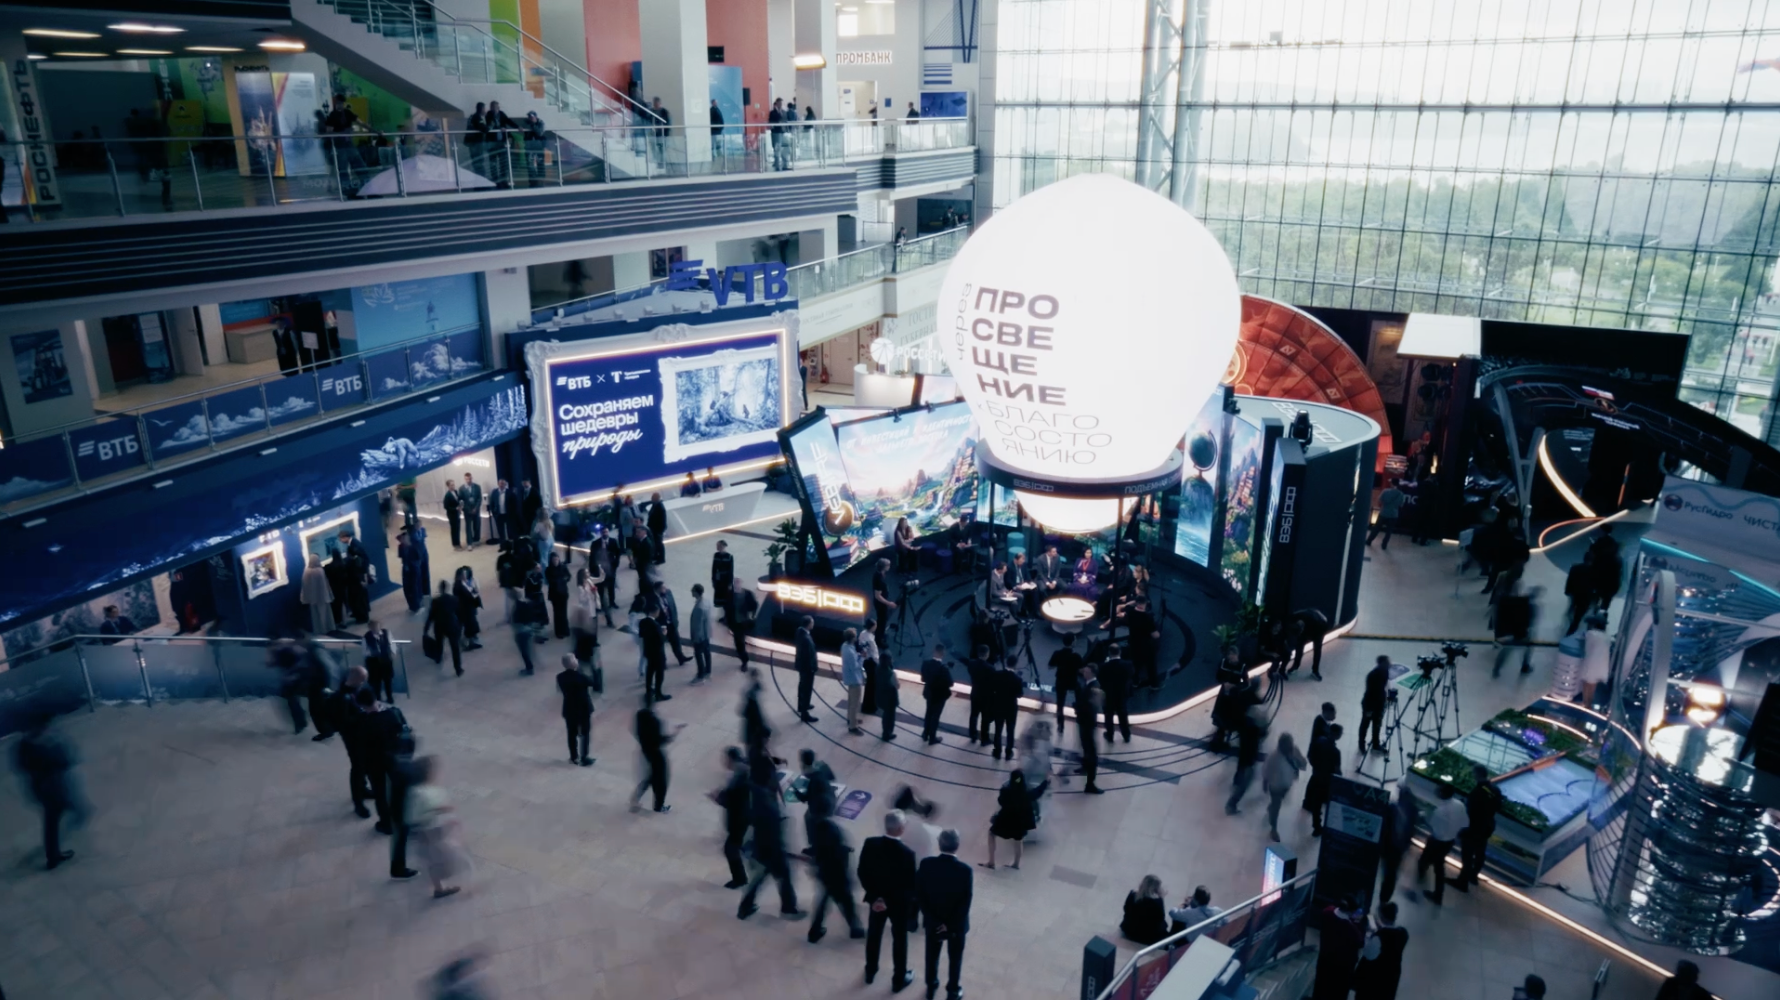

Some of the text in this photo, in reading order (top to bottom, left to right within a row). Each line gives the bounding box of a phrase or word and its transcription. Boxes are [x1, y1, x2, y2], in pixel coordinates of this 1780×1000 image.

[13, 59, 55, 201] РОСНЕФТЬ
[706, 261, 788, 306] VTB
[974, 286, 1060, 320] ПРО
[972, 318, 1054, 351] СВЕ
[972, 346, 1037, 376] ЩЕ
[335, 375, 362, 395] ВТБ
[567, 376, 591, 390] ВТБ
[976, 372, 1066, 406] НИЕ
[559, 394, 654, 420] Сохраняем
[985, 400, 1099, 430] БЛАГО
[561, 411, 639, 436] шедевры
[994, 419, 1112, 447] СОСТО
[97, 434, 139, 461] ВТБ
[562, 428, 643, 460] природы
[1001, 437, 1096, 465] ЯНИЮ
[1684, 501, 1734, 520] РусГидро
